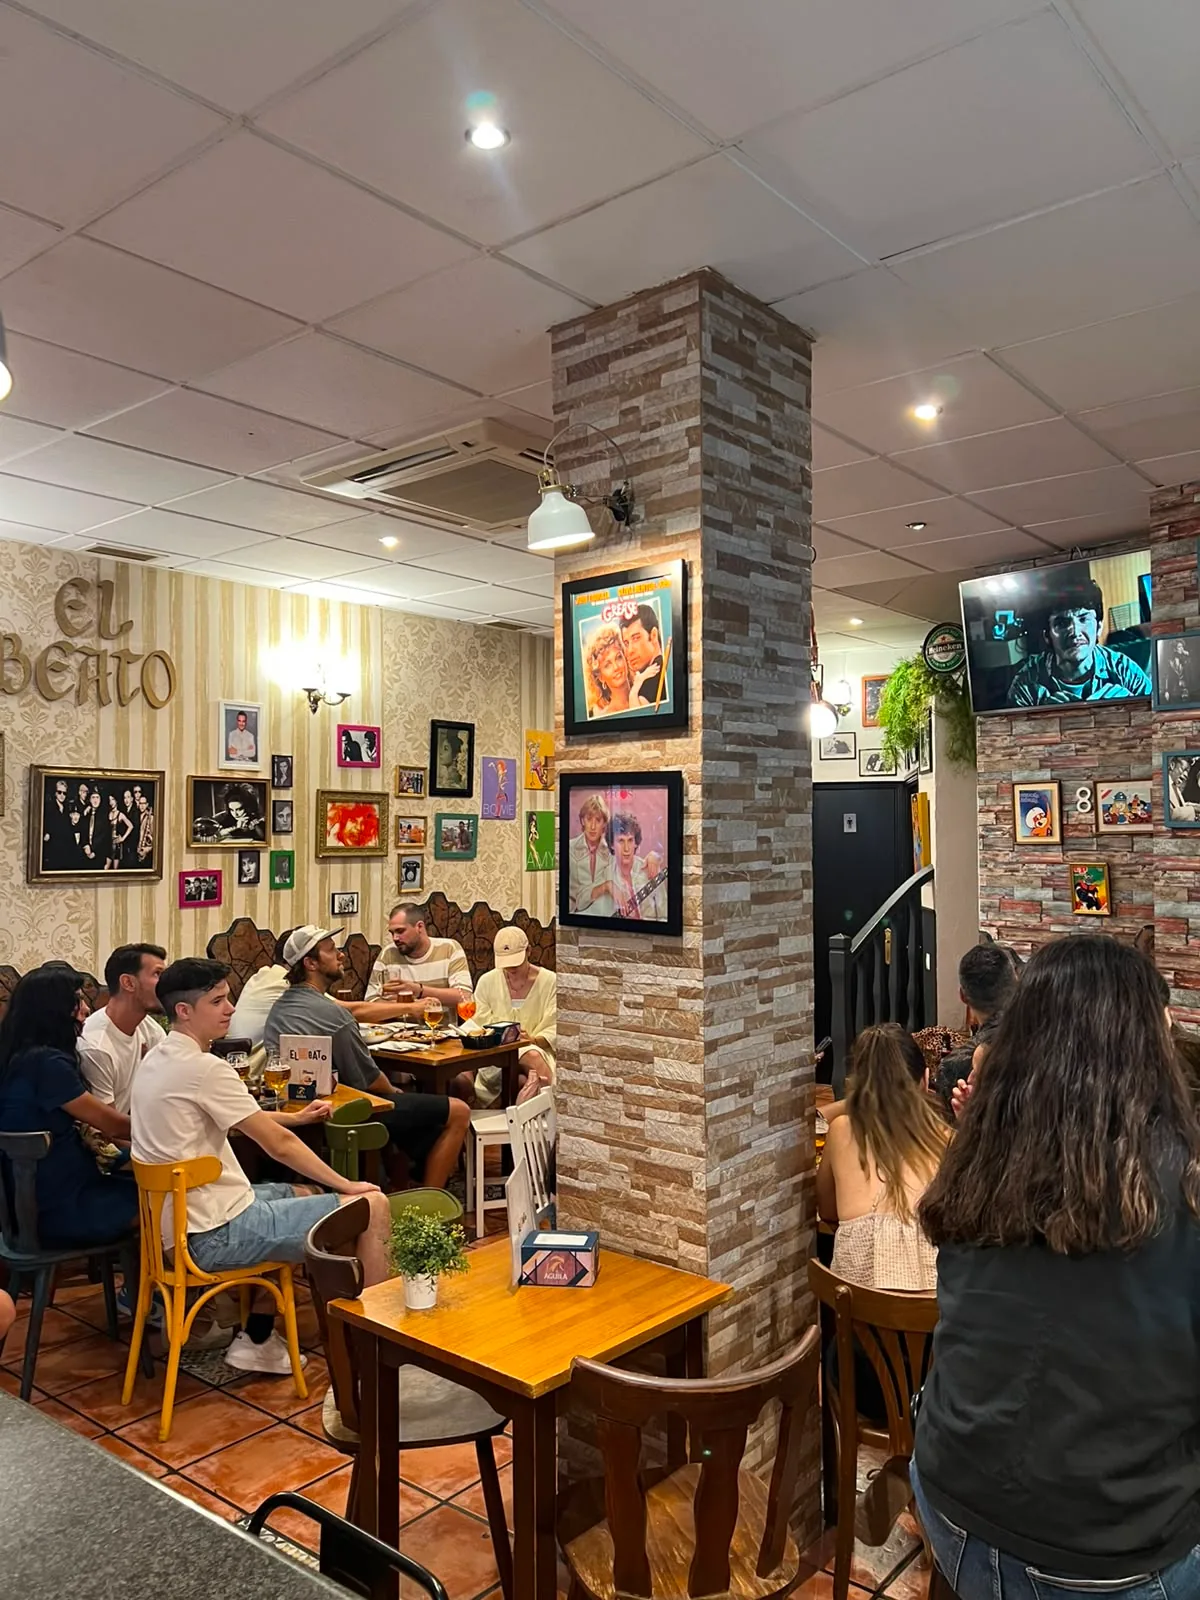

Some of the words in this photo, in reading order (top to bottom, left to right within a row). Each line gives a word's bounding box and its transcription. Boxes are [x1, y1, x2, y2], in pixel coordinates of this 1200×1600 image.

[602, 600, 638, 623] GREASE
[928, 643, 962, 655] Heineken
[1076, 786, 1092, 813] 8
[526, 851, 555, 870] AMY
[290, 1049, 299, 1061] EL
